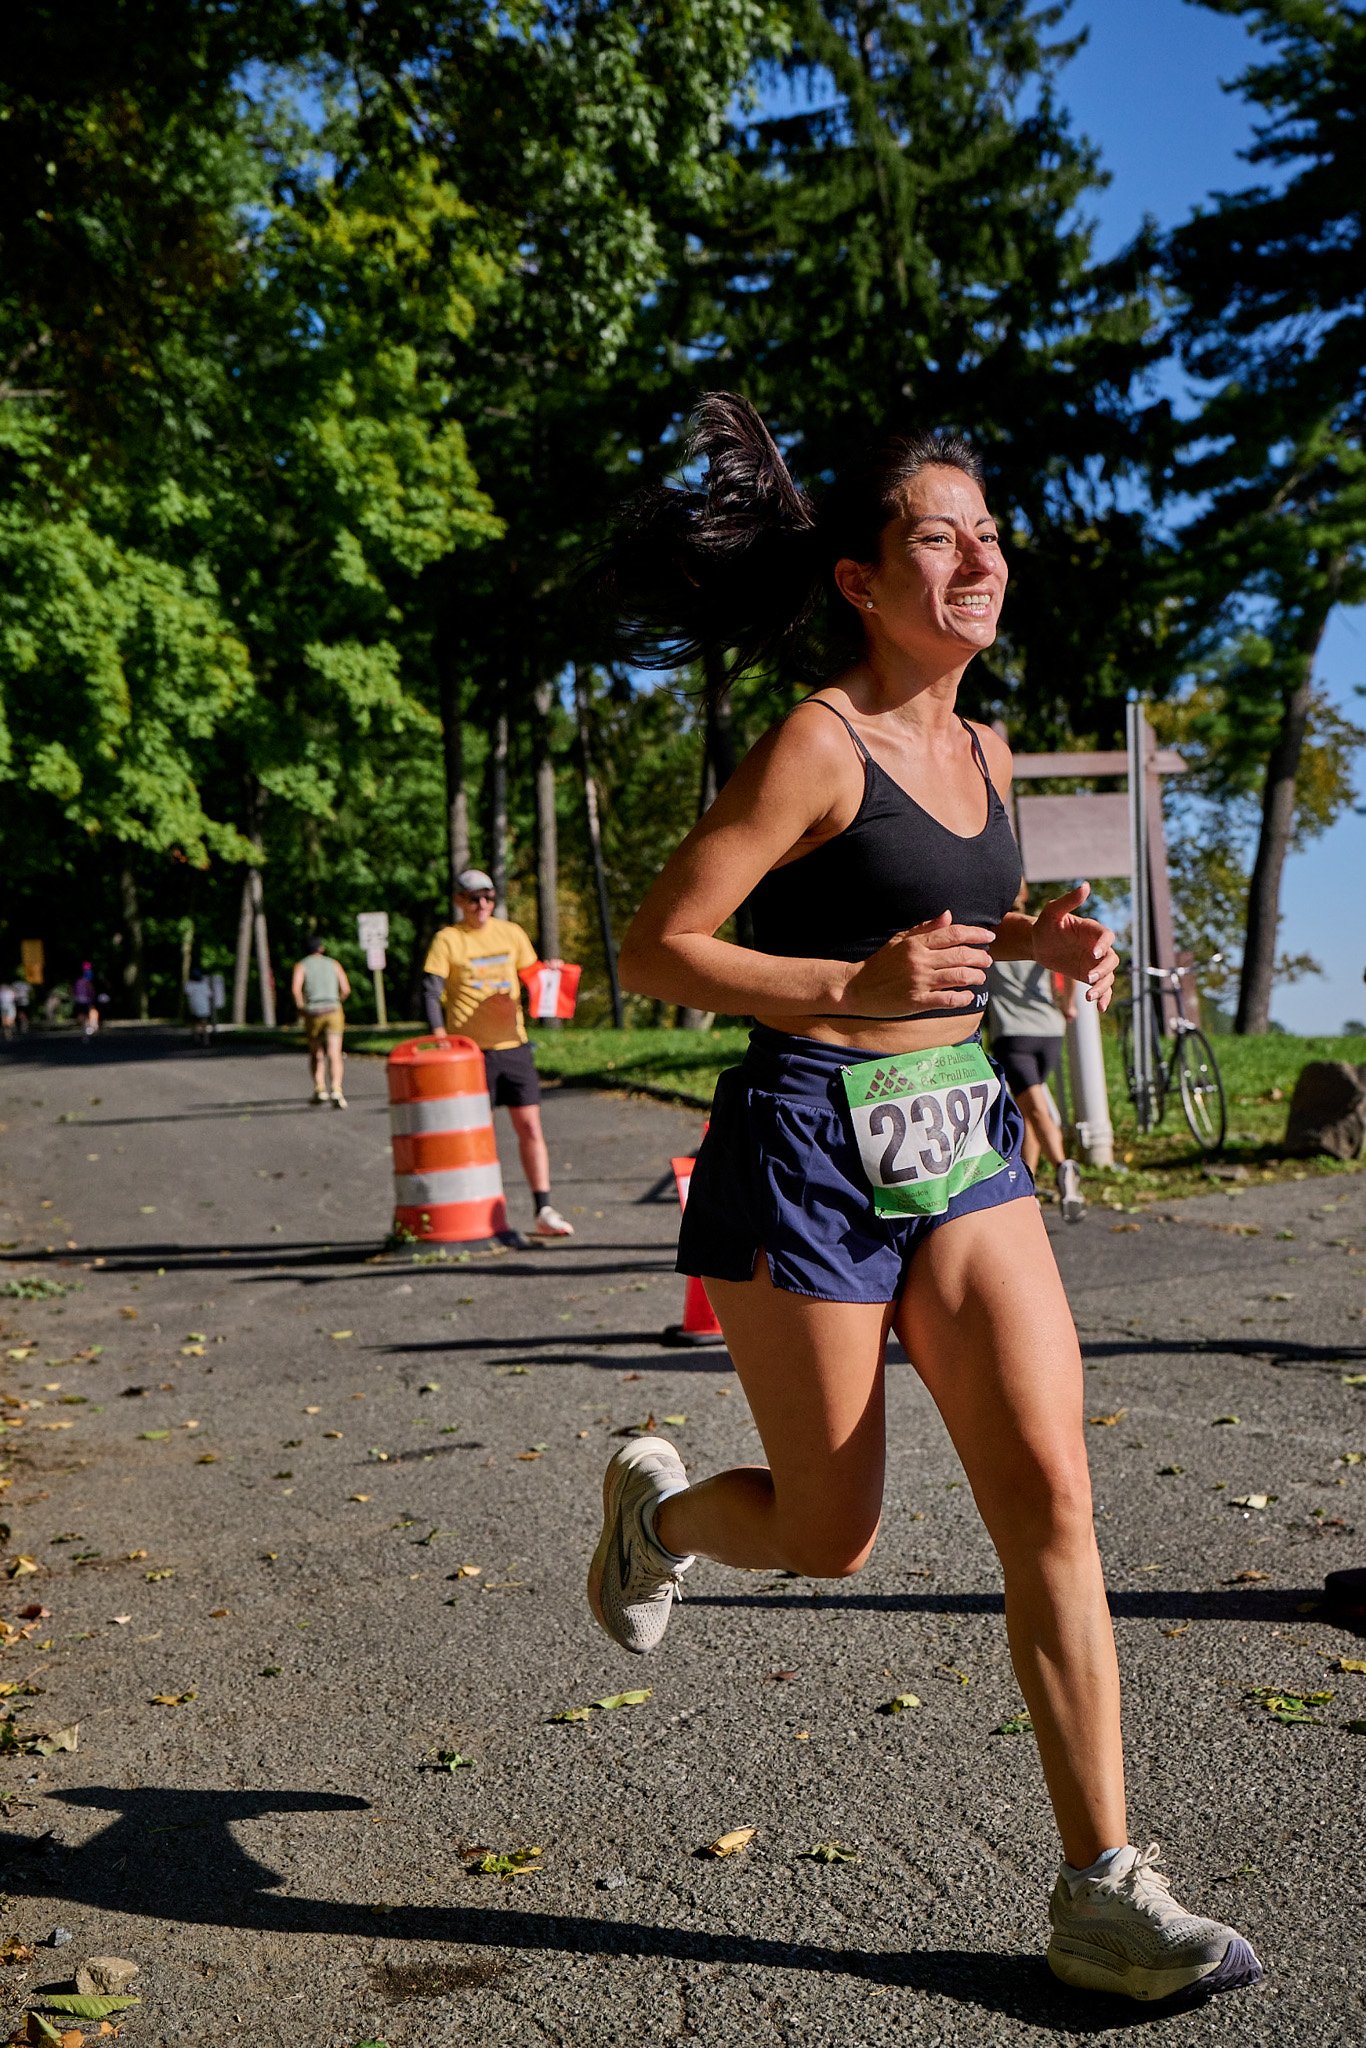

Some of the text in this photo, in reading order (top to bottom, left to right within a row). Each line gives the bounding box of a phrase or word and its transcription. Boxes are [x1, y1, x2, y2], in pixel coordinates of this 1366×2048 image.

[939, 1069, 961, 1082] Trail
[962, 1068, 978, 1079] Run
[869, 1084, 989, 1185] 2387
